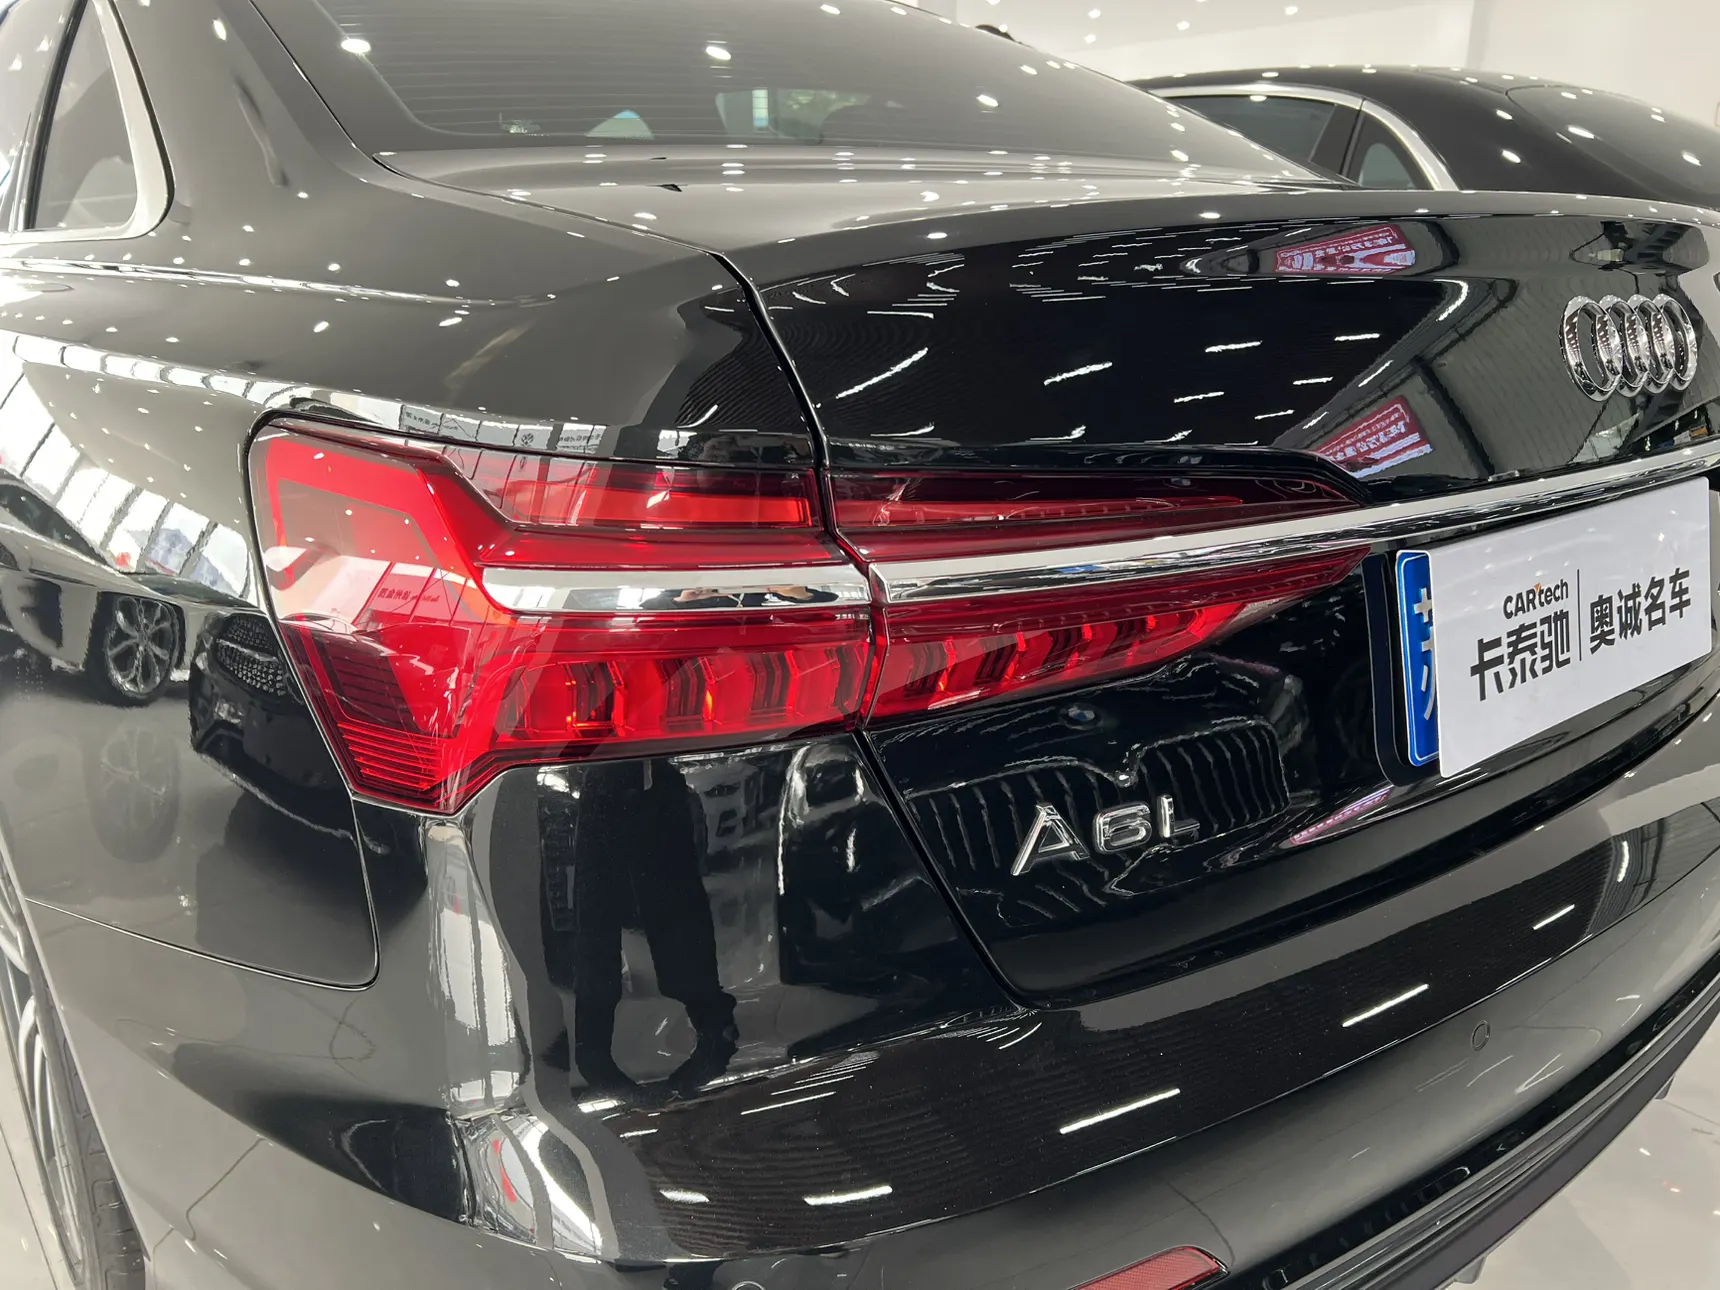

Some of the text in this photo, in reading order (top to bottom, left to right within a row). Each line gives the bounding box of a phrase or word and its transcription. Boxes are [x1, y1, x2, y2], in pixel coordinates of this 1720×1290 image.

[1589, 567, 1691, 654] 奥诚名车
[1470, 608, 1571, 701] 卡泰驰
[1011, 795, 1200, 876] A6L
